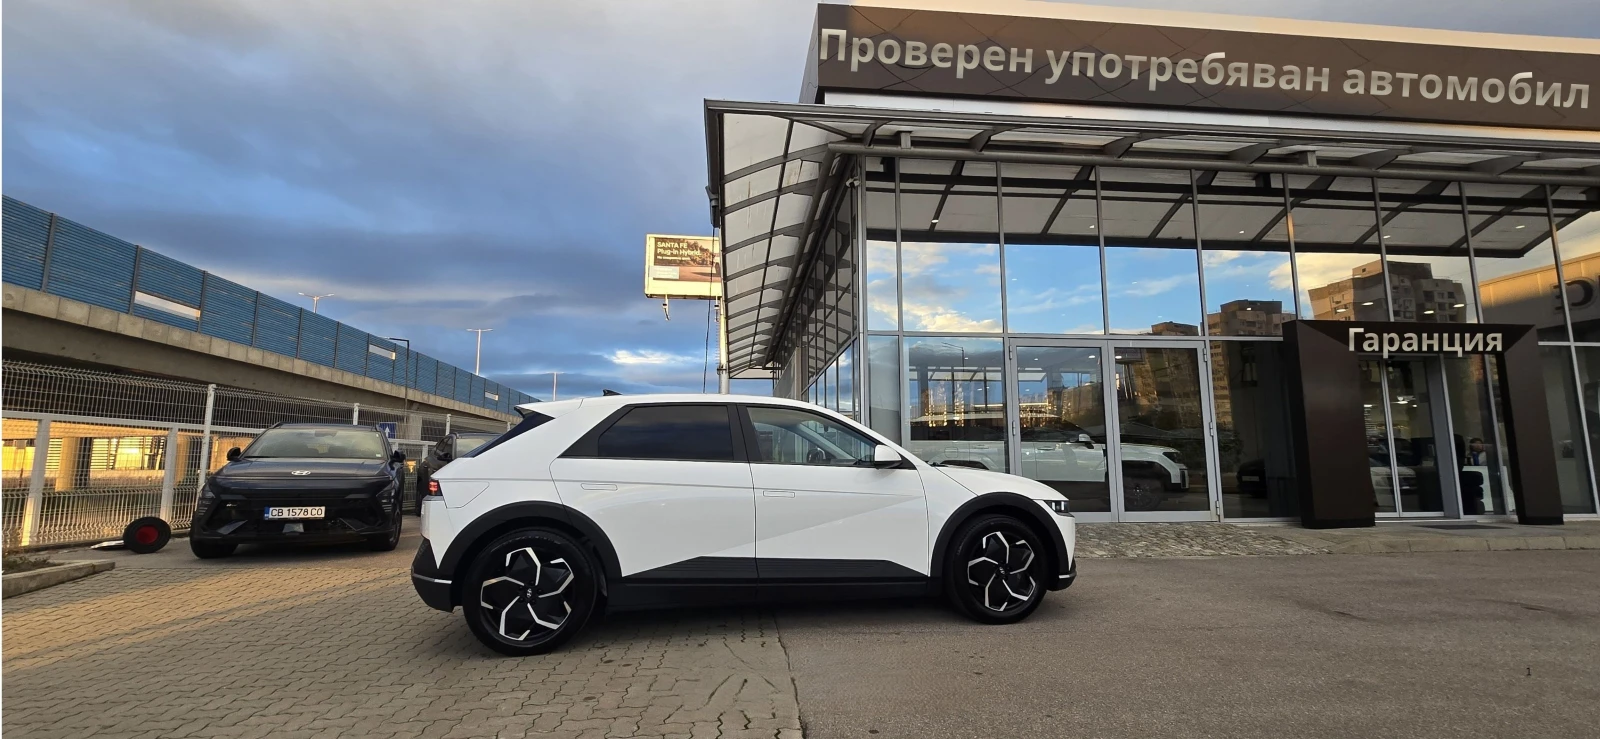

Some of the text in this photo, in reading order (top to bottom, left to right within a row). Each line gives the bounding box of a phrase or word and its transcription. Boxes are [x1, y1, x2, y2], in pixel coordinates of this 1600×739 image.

[657, 248, 679, 256] Plug-in
[271, 508, 323, 517] CB 1578 CO
